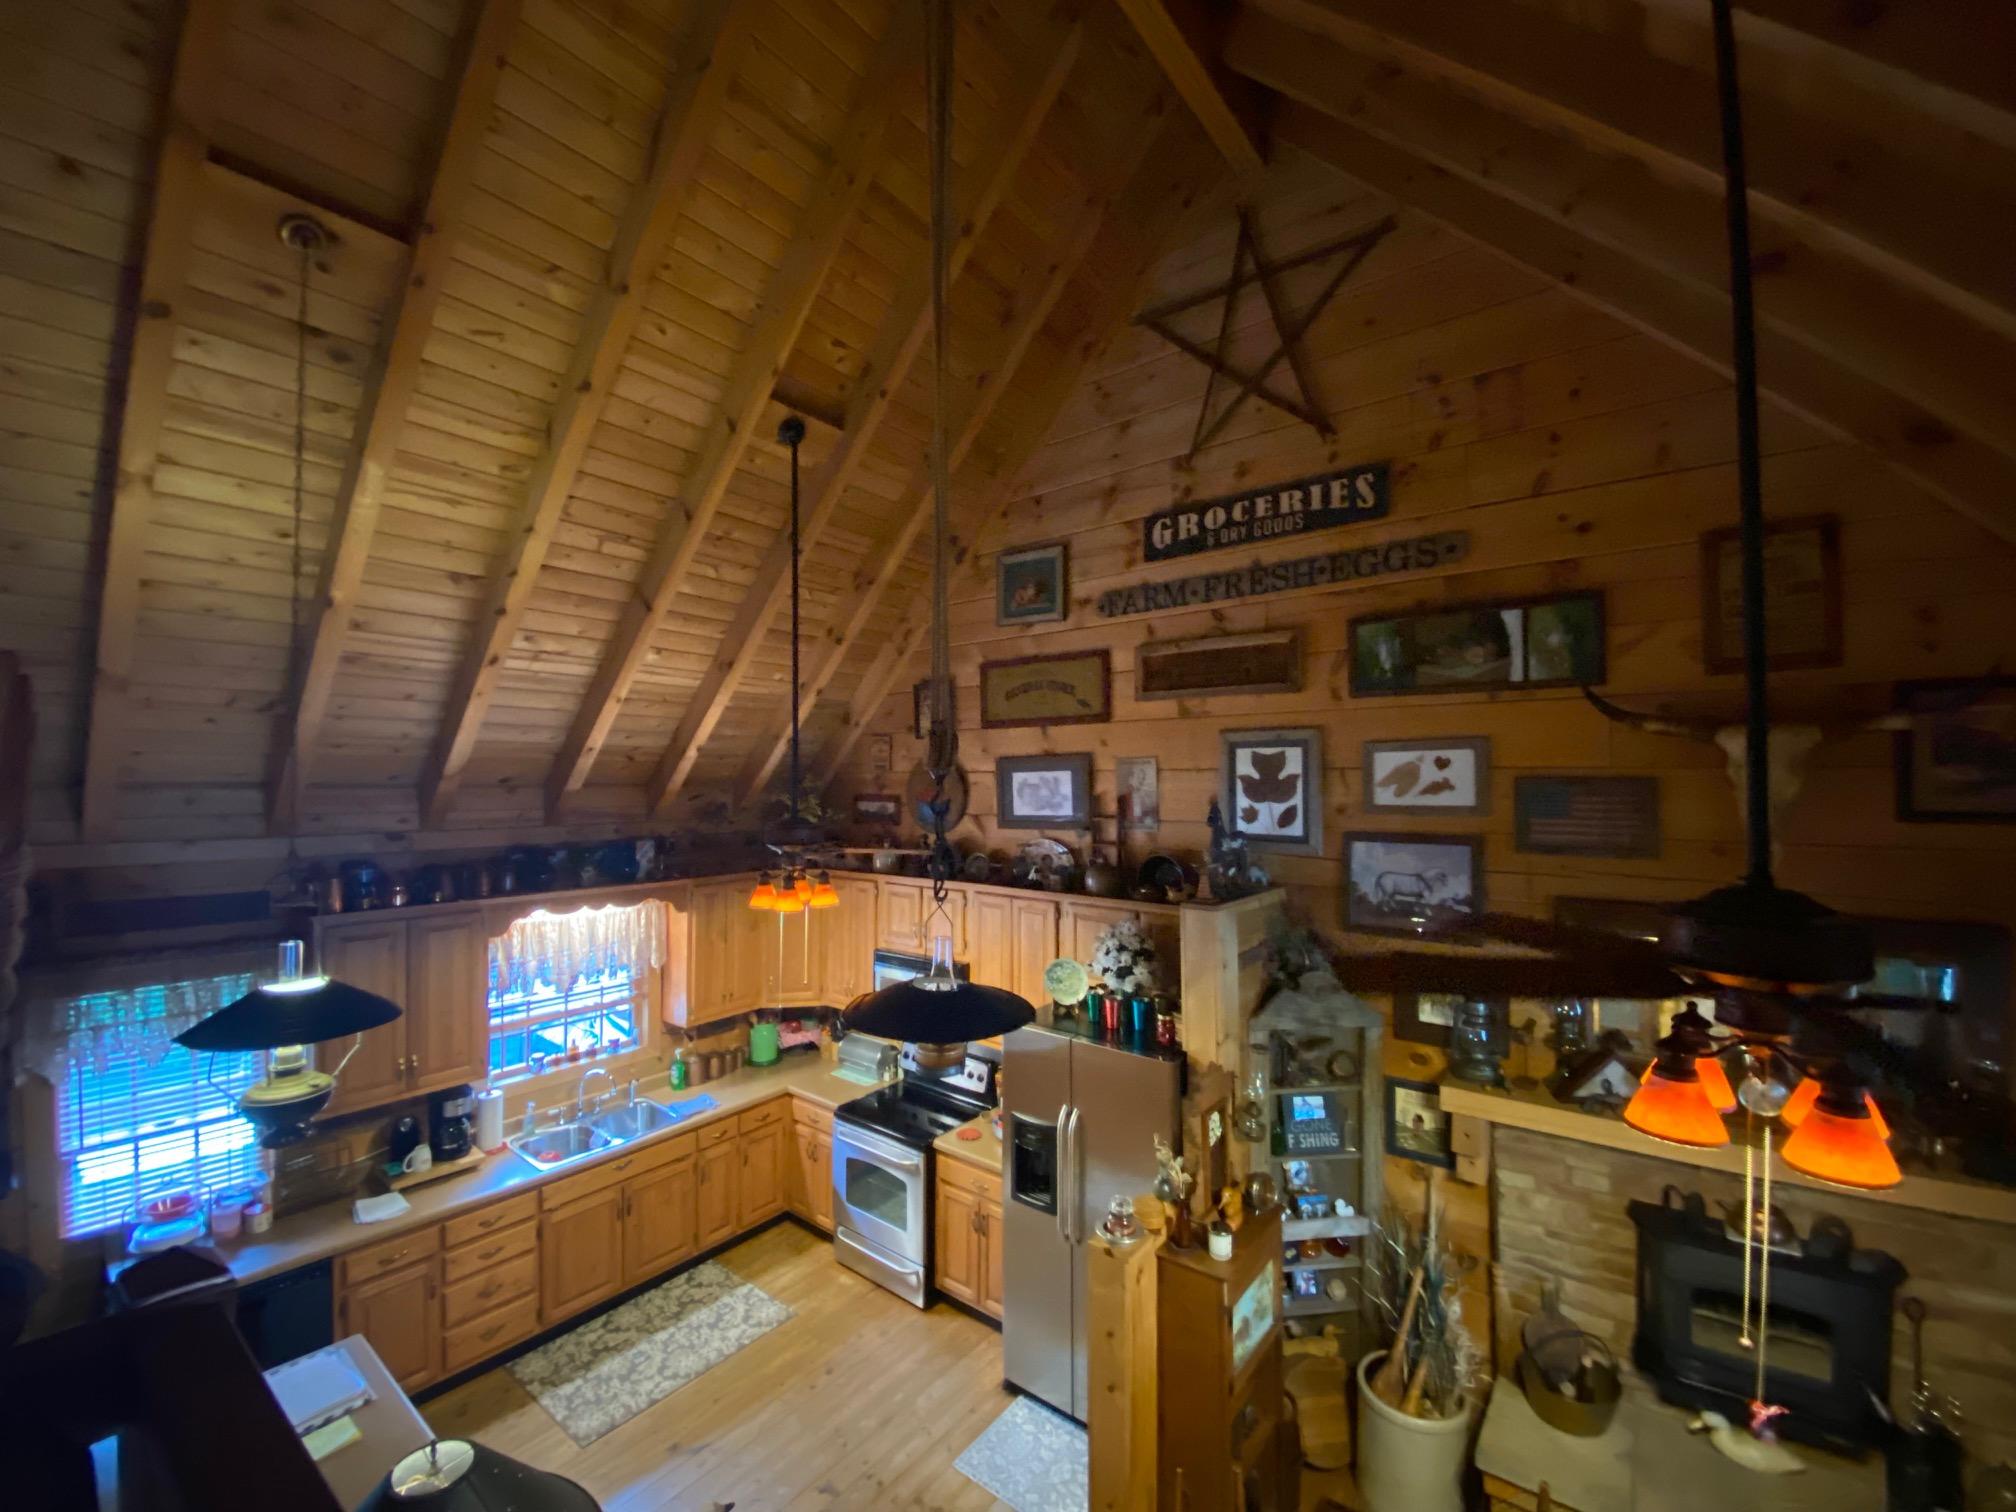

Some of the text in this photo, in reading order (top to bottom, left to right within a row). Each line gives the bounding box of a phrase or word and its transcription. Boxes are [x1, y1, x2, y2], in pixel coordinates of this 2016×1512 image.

[1152, 472, 1376, 549] GROCERIES
[1220, 525, 1248, 544] DRY
[1252, 512, 1304, 537] GOODS
[1105, 538, 1439, 617] FARM FRESH EGGS
[1287, 1132, 1340, 1148] FSHING
